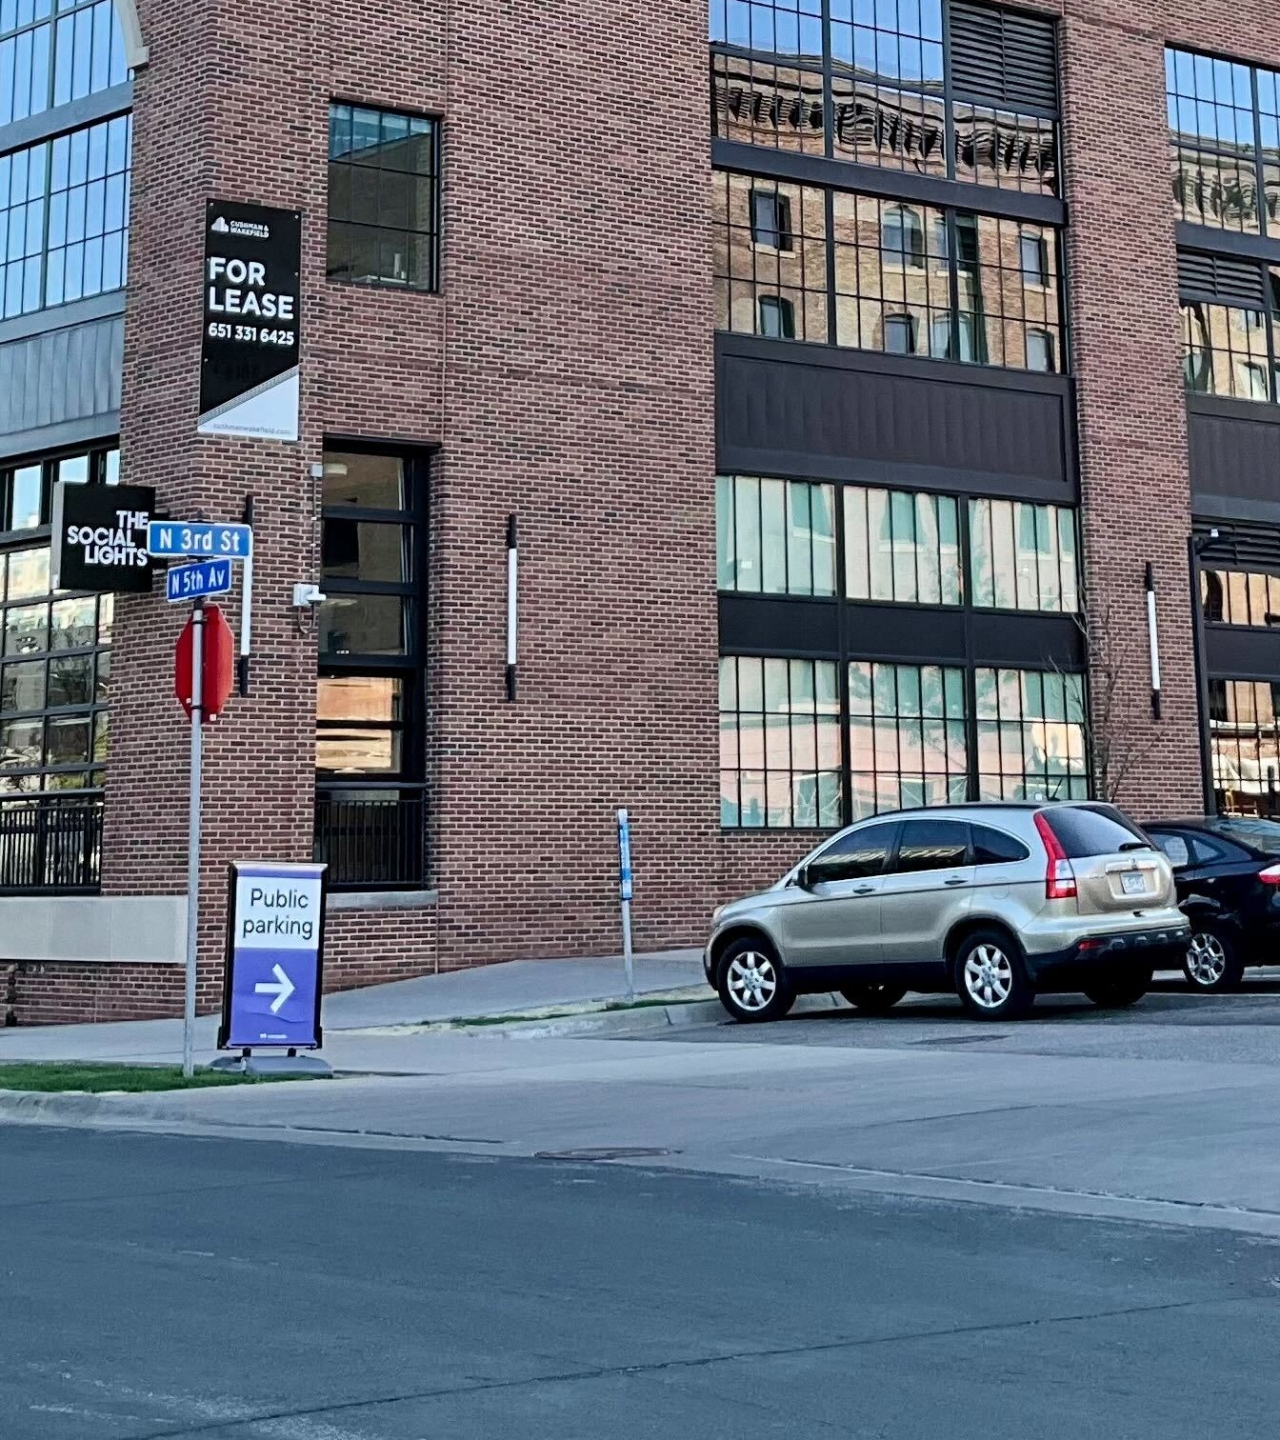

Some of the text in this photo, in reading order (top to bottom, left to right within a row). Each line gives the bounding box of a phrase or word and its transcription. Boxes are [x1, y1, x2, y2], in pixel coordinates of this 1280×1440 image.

[230, 227, 270, 238] WAKEFIELD
[209, 256, 266, 286] FOR
[209, 286, 294, 320] LEASE
[208, 322, 294, 346] 651 331 6425
[116, 510, 149, 530] THE
[67, 525, 136, 547] SOCIAL
[160, 528, 240, 552] N 3rd St
[84, 545, 148, 567] LIGHTS
[172, 566, 225, 595] N 5th Av
[250, 888, 309, 909] Public
[242, 915, 314, 940] parking
